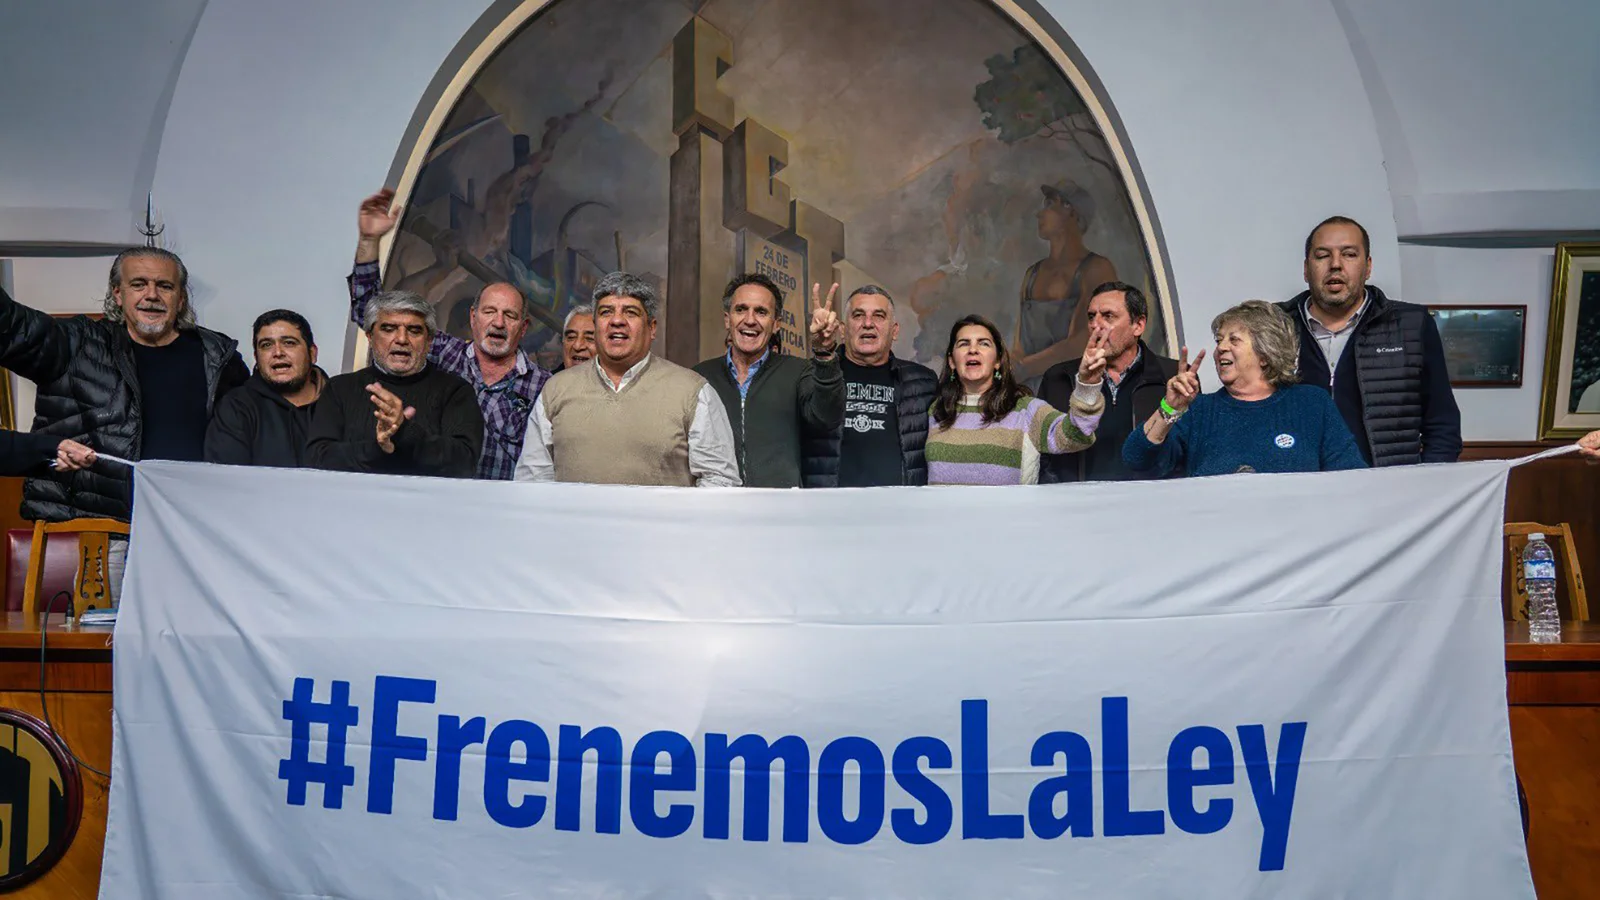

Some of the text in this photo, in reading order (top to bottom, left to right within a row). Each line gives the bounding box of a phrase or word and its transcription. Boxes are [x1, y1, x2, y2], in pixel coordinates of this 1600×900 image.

[763, 245, 789, 270] 24 DE
[755, 259, 797, 291] FEBRERO
[780, 327, 805, 351] TICIA
[846, 382, 895, 403] EMEN
[278, 676, 1306, 871] #FrenemosLaLey
